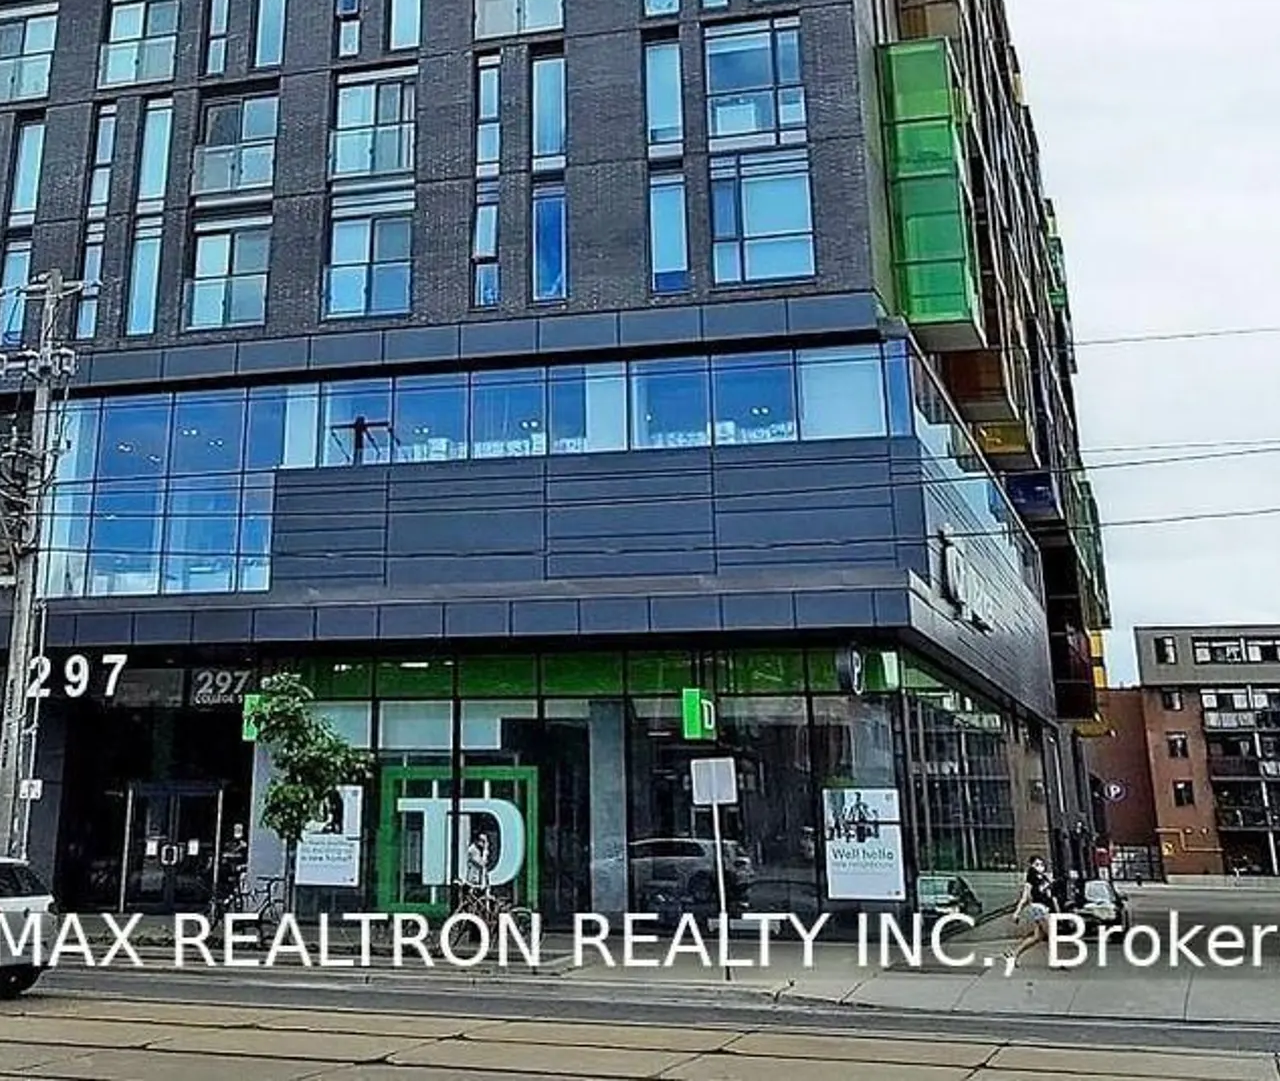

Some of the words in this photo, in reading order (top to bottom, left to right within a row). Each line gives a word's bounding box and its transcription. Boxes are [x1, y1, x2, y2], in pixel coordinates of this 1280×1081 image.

[25, 654, 128, 698] 297
[196, 671, 251, 694] 297
[397, 798, 526, 887] TD
